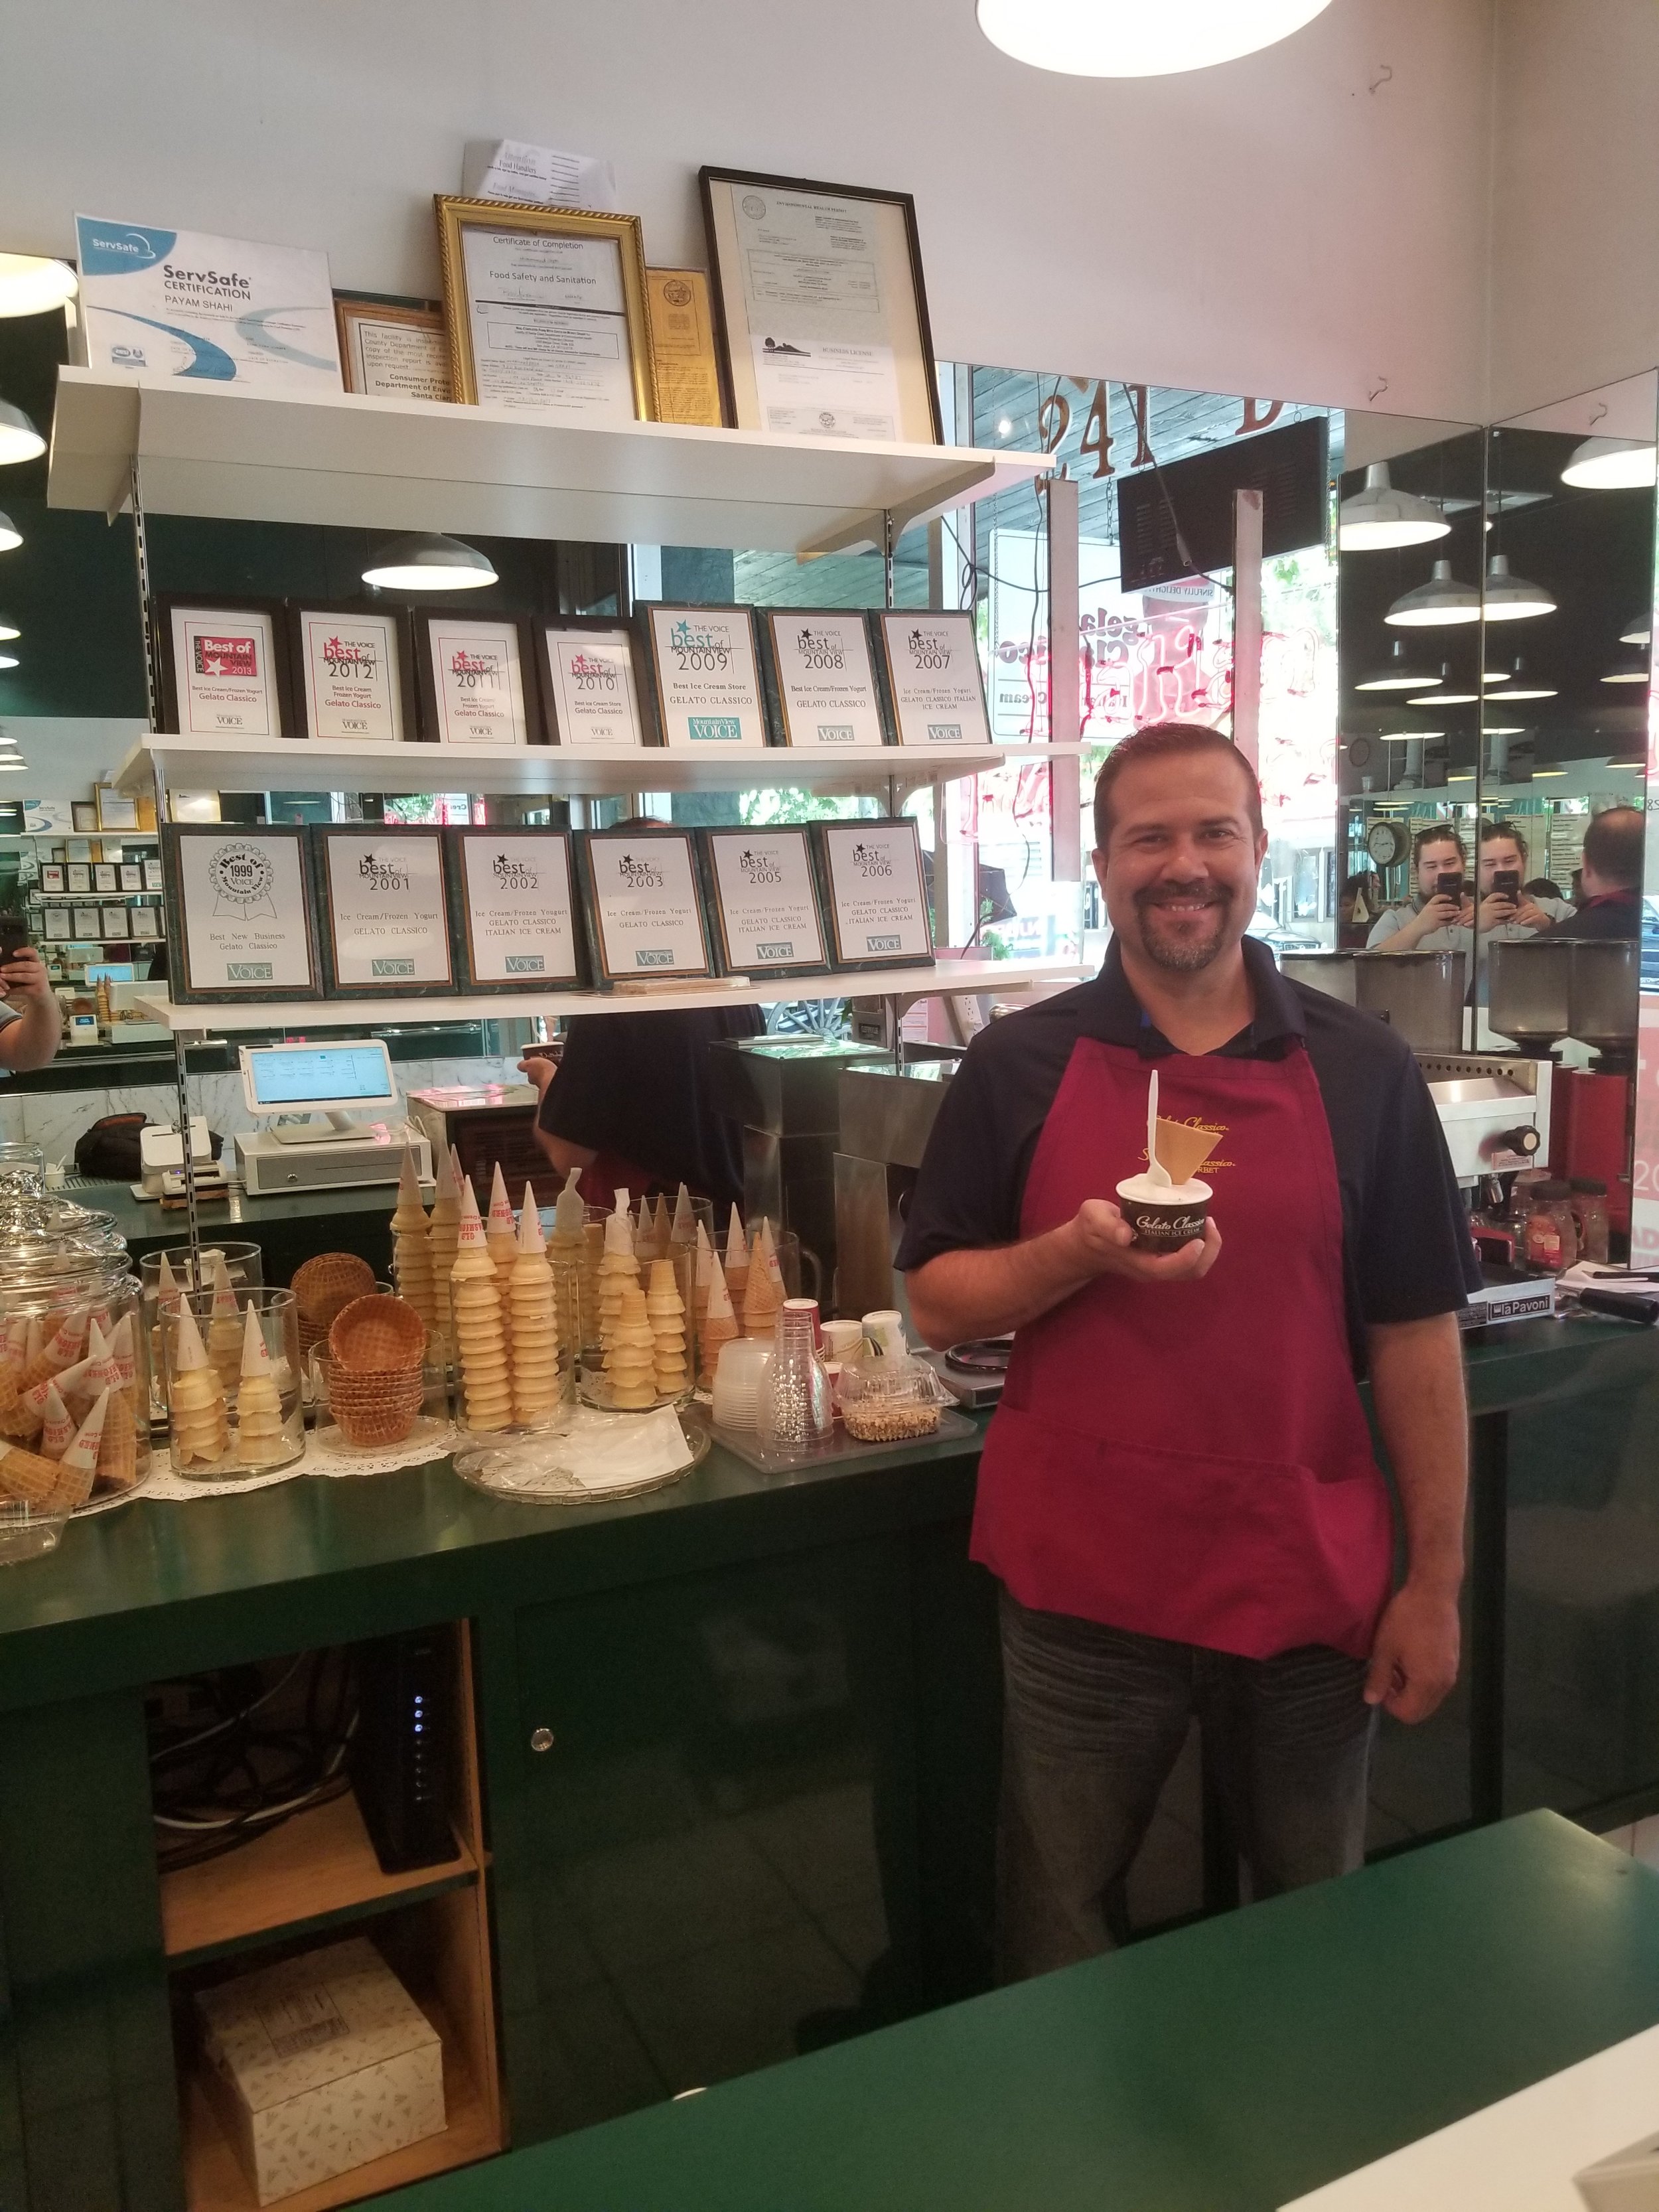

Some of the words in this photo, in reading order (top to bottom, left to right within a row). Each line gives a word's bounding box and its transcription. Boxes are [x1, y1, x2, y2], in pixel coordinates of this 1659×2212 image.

[93, 239, 139, 252] ServSafe
[493, 236, 531, 246] Certificate
[542, 240, 583, 249] Completion
[490, 271, 510, 279] Food
[512, 272, 537, 282] Safety
[556, 275, 597, 284] Sanitation
[164, 280, 251, 301] CERTIFICATION
[165, 295, 200, 308] PAYAM
[203, 301, 233, 312] SHAHI
[390, 342, 427, 350] Department
[376, 380, 421, 390] Department
[390, 374, 427, 383] Consumer
[670, 628, 713, 648] best
[797, 634, 830, 650] best
[908, 635, 938, 650] best
[204, 639, 234, 652] Best
[236, 641, 252, 654] of
[324, 642, 361, 660] best
[452, 656, 486, 672] best
[571, 660, 603, 674] best
[676, 652, 727, 671] 2009
[803, 654, 843, 669] 2008
[914, 654, 950, 669] 2007
[328, 662, 374, 679] 2012
[457, 674, 493, 688] 2011
[576, 677, 614, 690] 2010
[352, 700, 381, 709] Classico
[216, 716, 243, 725] VOICE
[693, 725, 737, 738] VOICE
[220, 853, 246, 869] Best
[740, 855, 768, 869] best
[853, 849, 879, 862] best
[230, 865, 253, 877] 1999
[359, 859, 395, 875] best
[493, 860, 525, 874] best
[619, 859, 650, 873] best
[861, 865, 892, 877] 2006
[500, 877, 538, 889] 2002
[626, 876, 663, 887] 2003
[749, 871, 781, 883] 2005
[370, 878, 409, 891] 2001
[414, 913, 438, 921] Yogurt
[757, 945, 792, 959] VOICE
[867, 938, 901, 952] VOICE
[506, 957, 544, 972] VOICE
[637, 952, 674, 965] VOICE
[228, 964, 272, 980] VOICE
[373, 960, 414, 975] VOICE
[1136, 1215, 1171, 1230] Gelato
[1512, 1297, 1549, 1314] Pavoni
